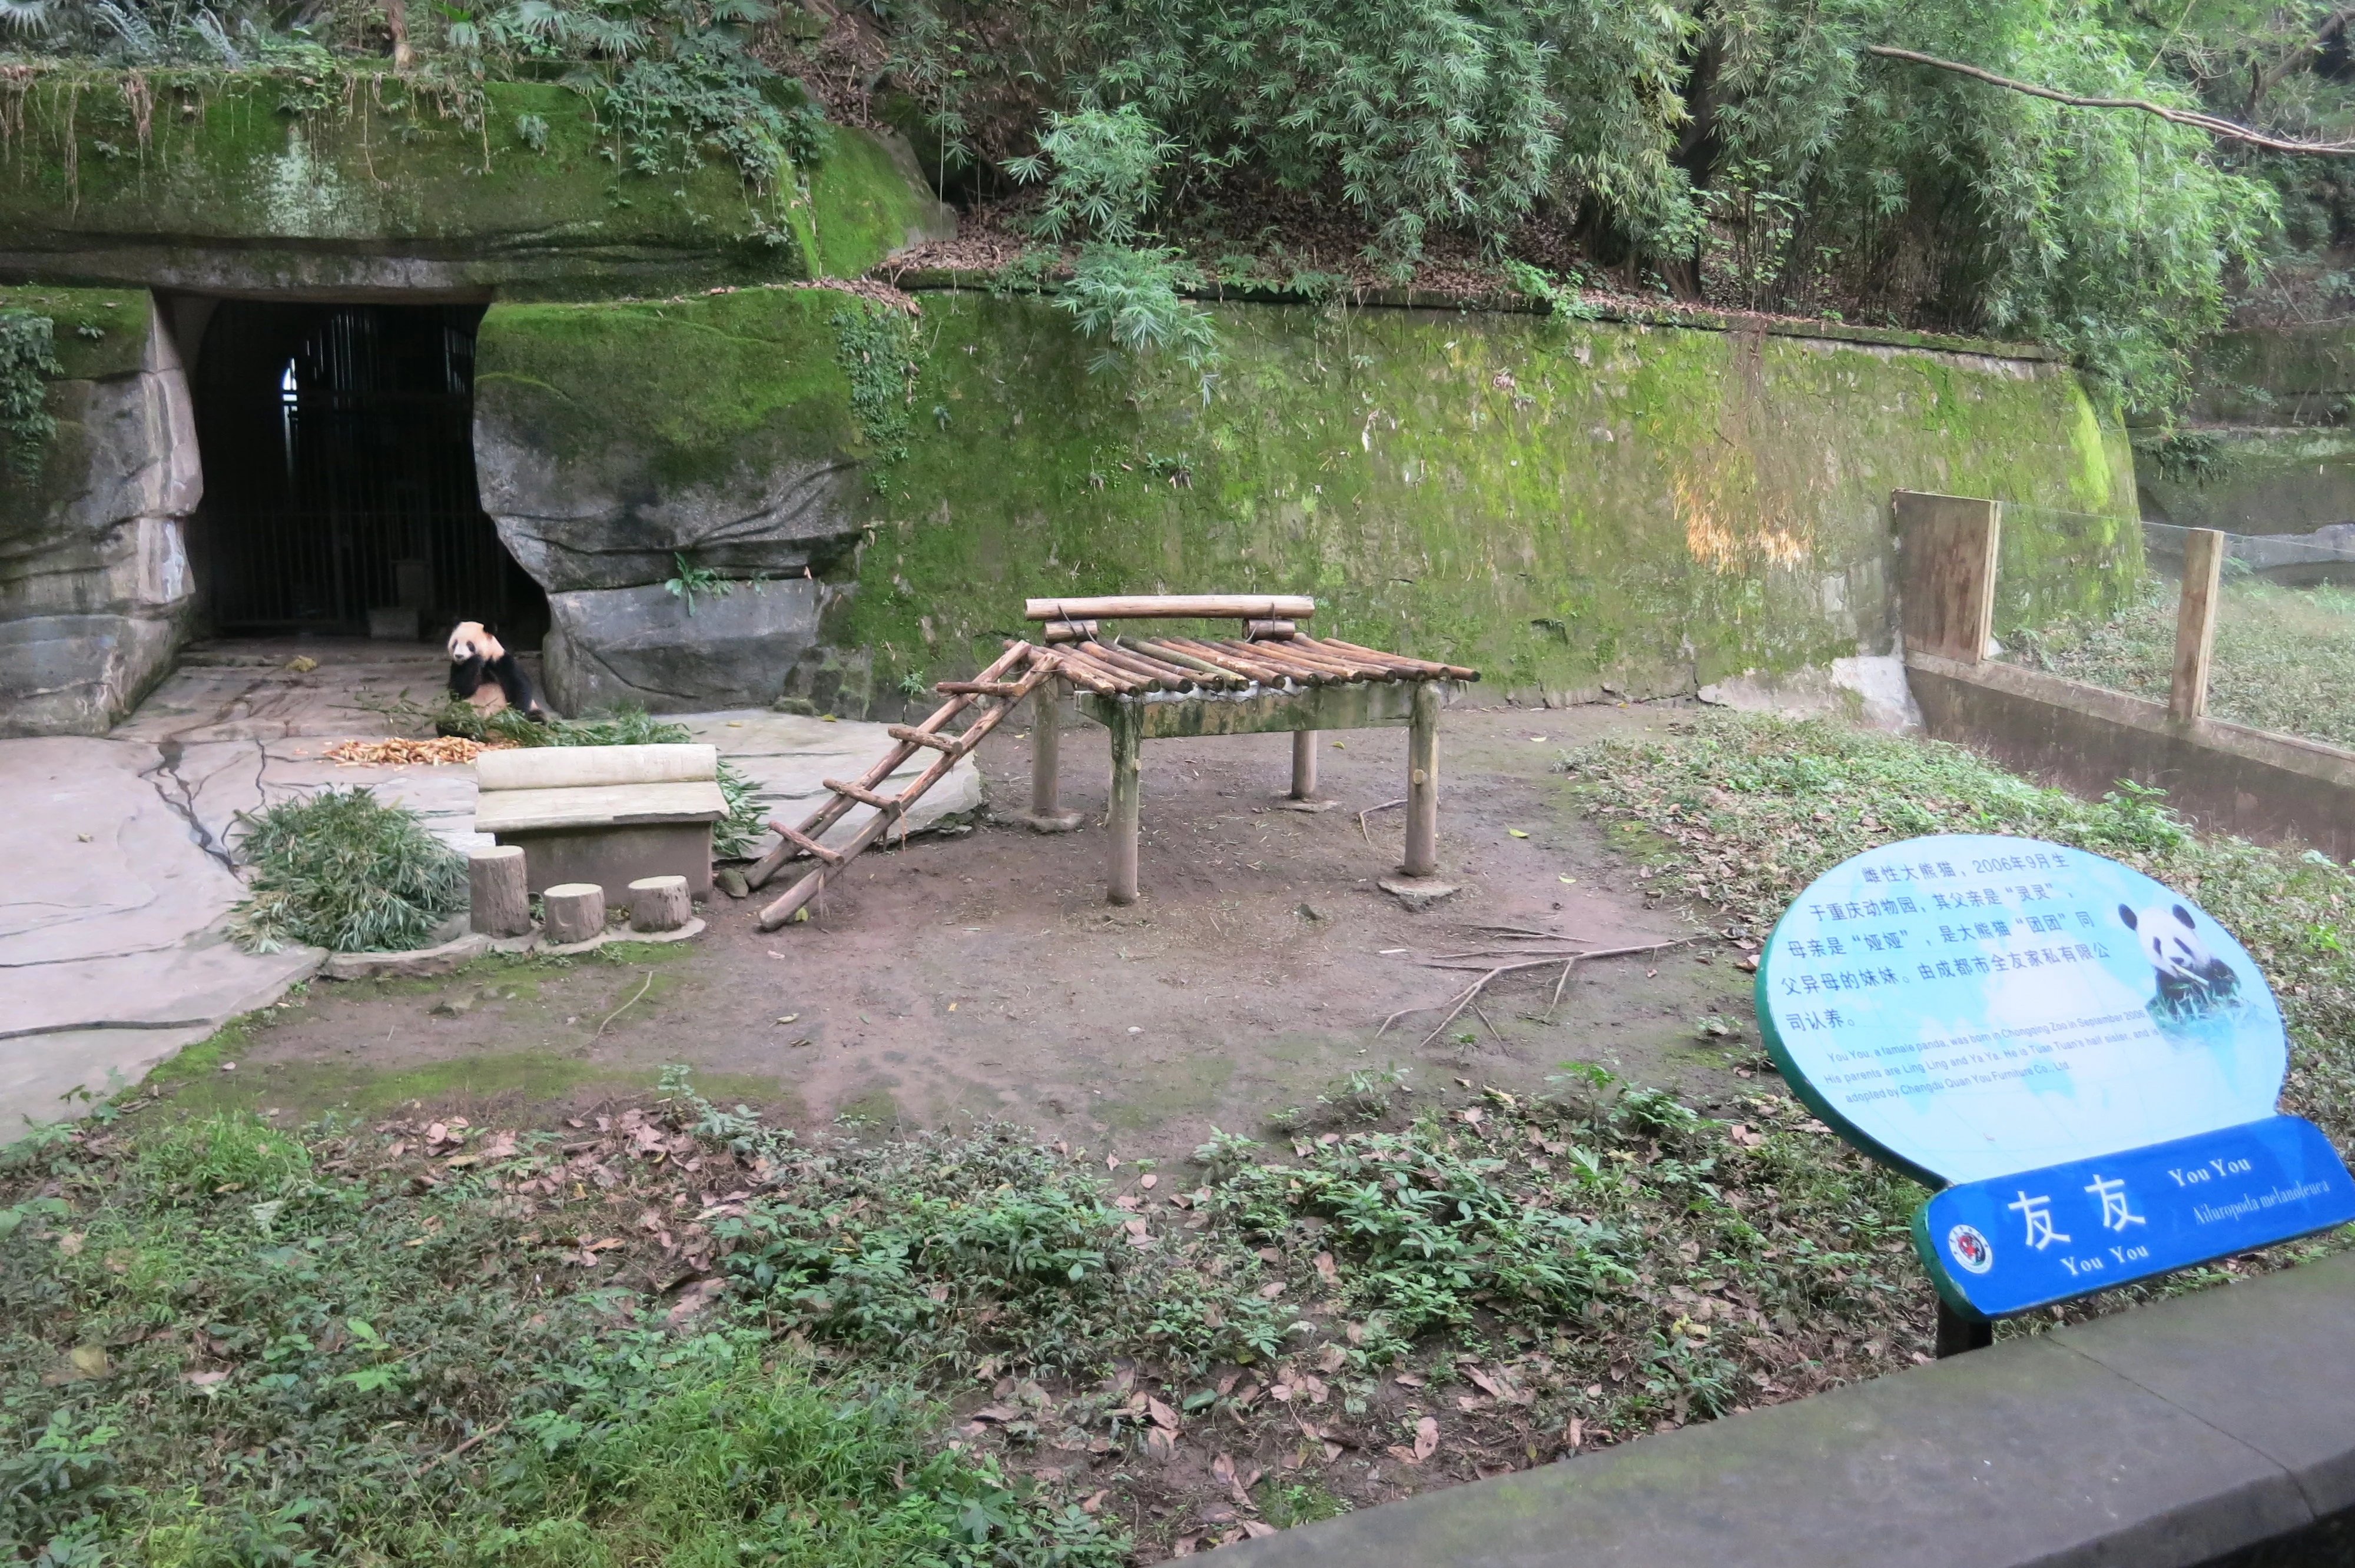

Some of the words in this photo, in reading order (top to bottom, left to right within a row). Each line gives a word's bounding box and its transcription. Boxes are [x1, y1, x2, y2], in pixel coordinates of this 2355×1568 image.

[1786, 1008, 1855, 1032] 司认养。
[1827, 1052, 1849, 1062] You
[1874, 1049, 1881, 1057] a
[1949, 1037, 1969, 1046] was
[1969, 1034, 1992, 1043] born
[1991, 1032, 2002, 1040] in
[2001, 1024, 2050, 1037] Chongqing
[2049, 1022, 2068, 1031] Zoo
[2067, 1020, 2077, 1029] in
[2077, 1014, 2124, 1027] September
[1823, 1074, 1842, 1084] His
[1844, 1069, 1882, 1084] parents
[1884, 1067, 1901, 1077] are
[1902, 1063, 1926, 1074] Ling
[1925, 1060, 1949, 1070] Ling
[1950, 1056, 1969, 1067] and
[1969, 1054, 1985, 1063] Ya
[2002, 1048, 2018, 1058] He
[2018, 1047, 2028, 1057] is
[2028, 1044, 2053, 1054] Tuan
[2054, 1039, 2085, 1051] Tuan's
[2084, 1035, 2103, 1046] half
[2132, 1029, 2150, 1039] and
[2150, 1028, 2160, 1036] is
[1845, 1088, 1886, 1103] adopted
[1886, 1088, 1900, 1099] by
[1900, 1079, 1945, 1095] Chengdu
[1944, 1077, 1972, 1088] Quan
[1971, 1074, 1992, 1084] You
[1991, 1067, 2034, 1080] Furniture
[2168, 1168, 2211, 1188] You
[2209, 1158, 2252, 1177] You
[2193, 1192, 2260, 1225] Ailuropoda
[2259, 1180, 2330, 1208] melanoleuca
[2059, 1255, 2104, 1277] You
[2108, 1244, 2149, 1264] You
